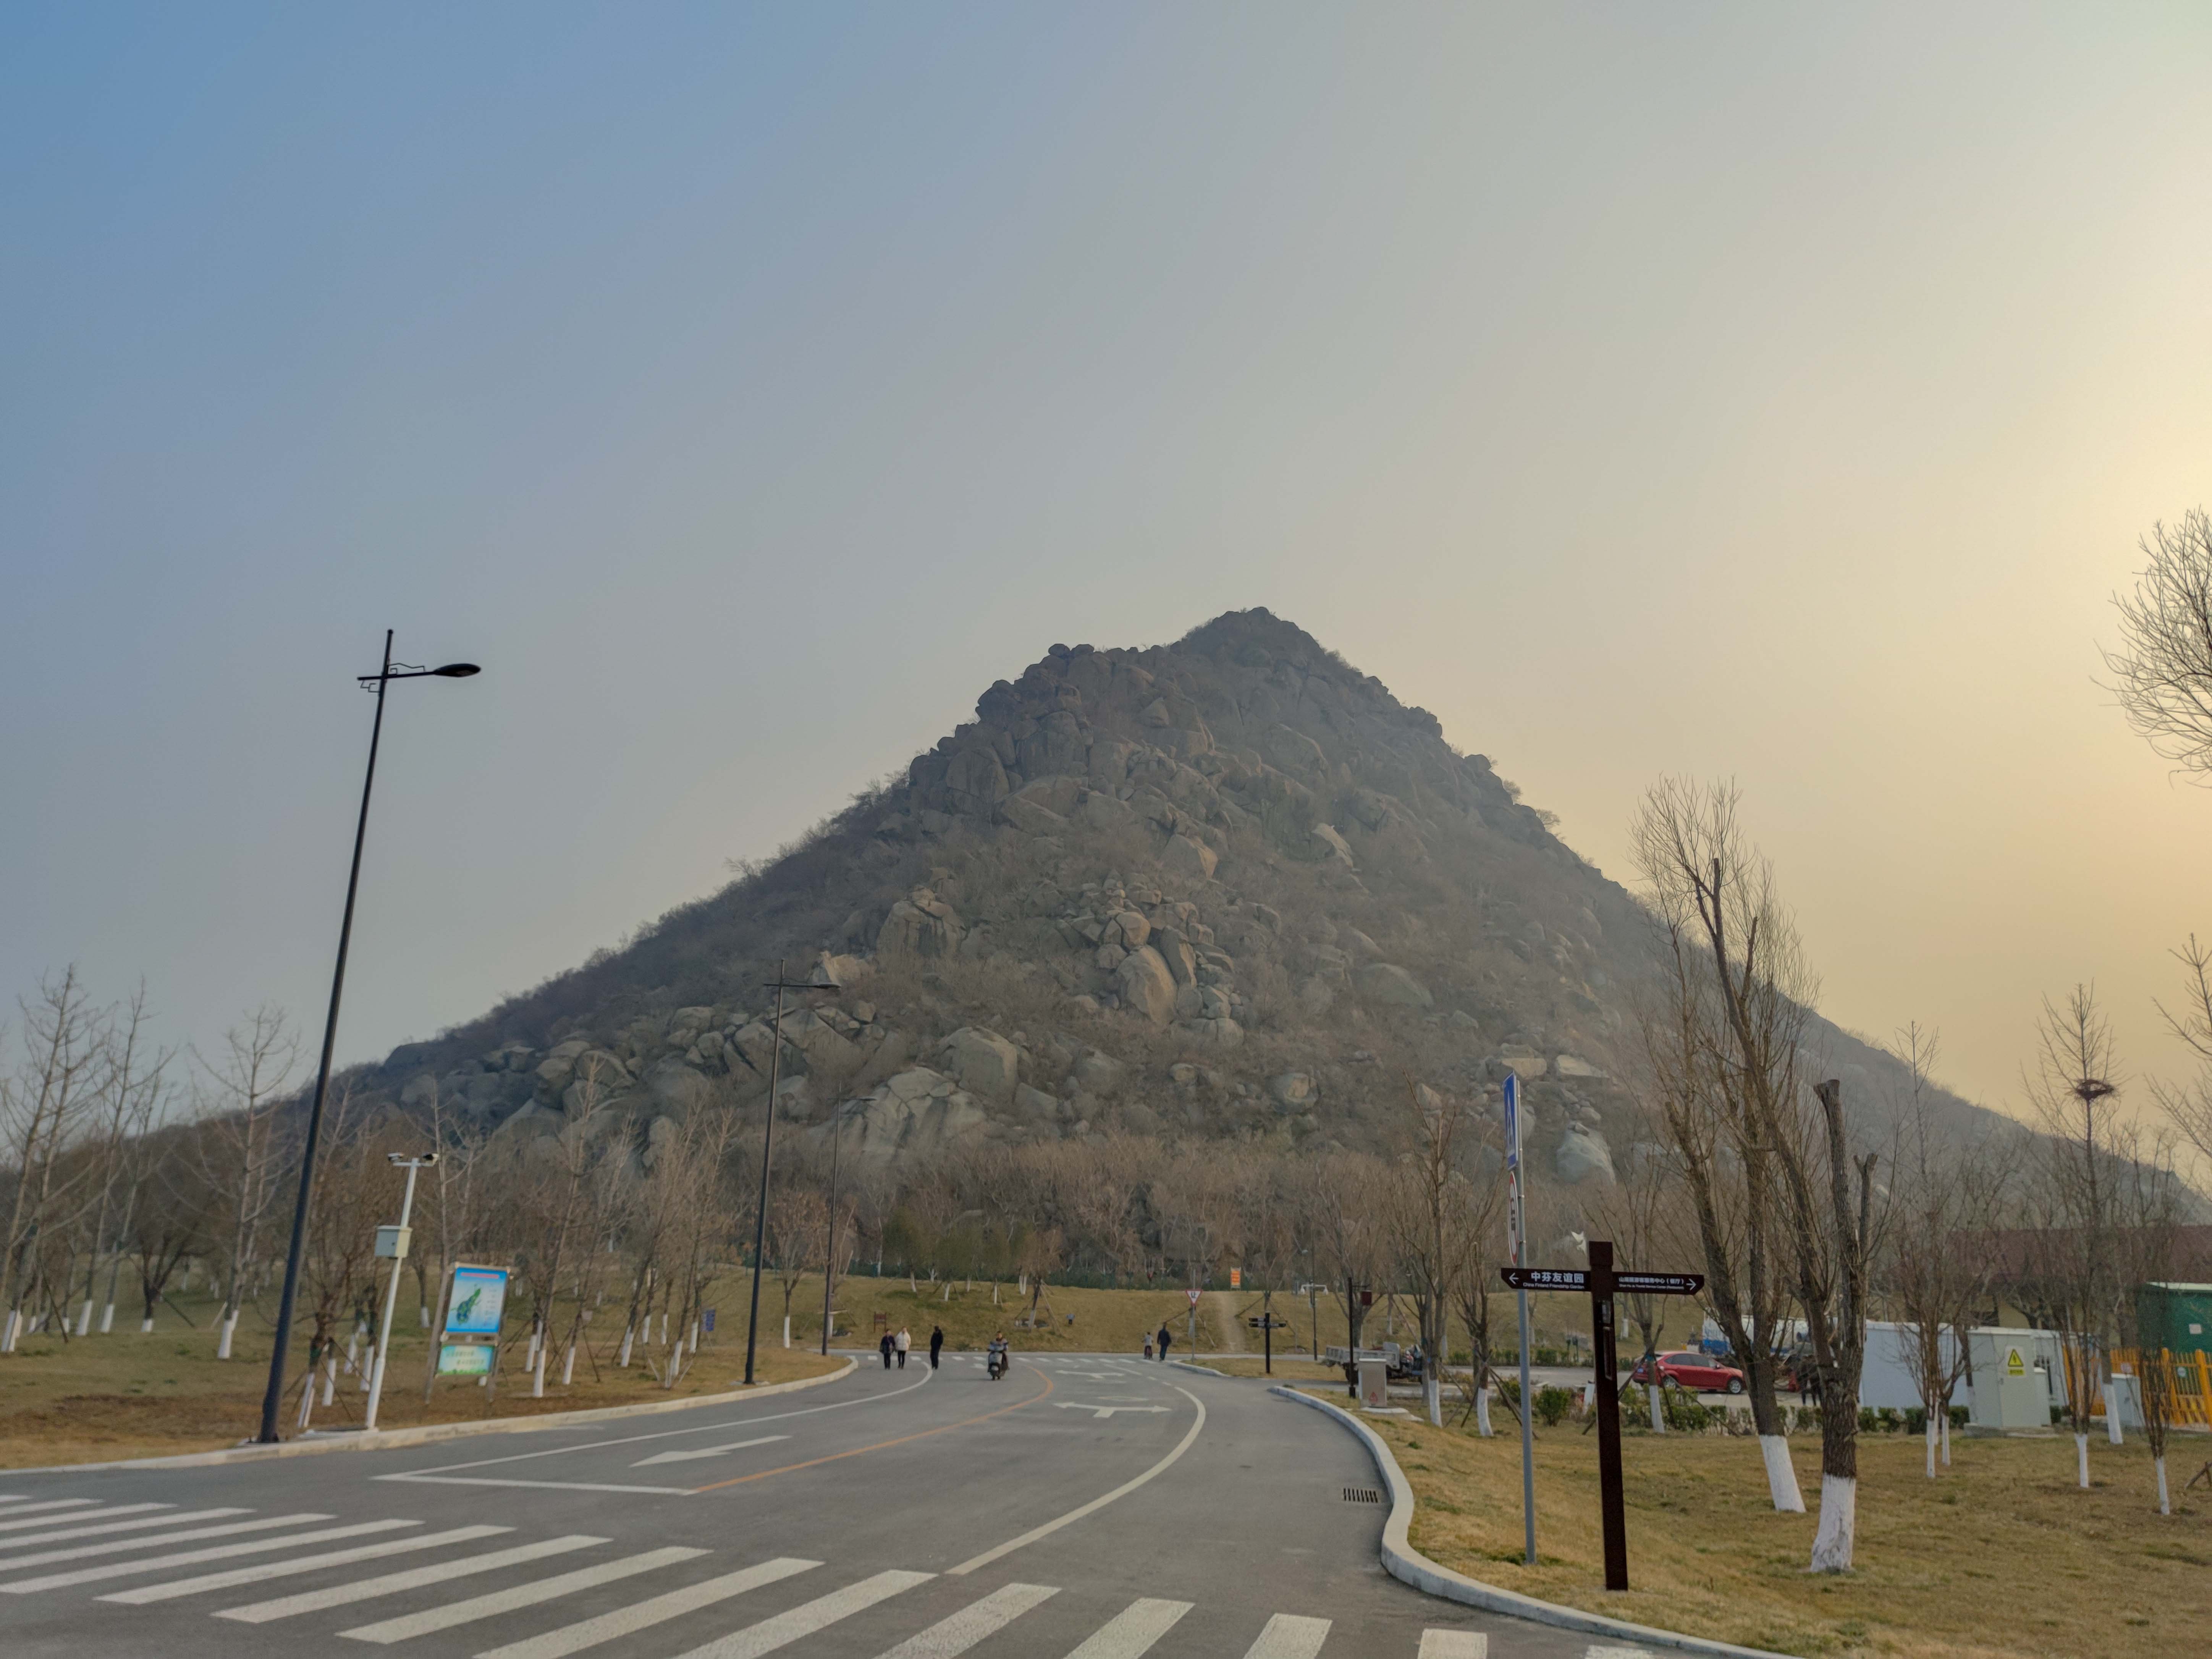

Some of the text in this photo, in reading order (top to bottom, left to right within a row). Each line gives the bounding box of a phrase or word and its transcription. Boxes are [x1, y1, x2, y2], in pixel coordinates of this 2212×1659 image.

[1531, 1271, 1584, 1284] 中芬友谊园
